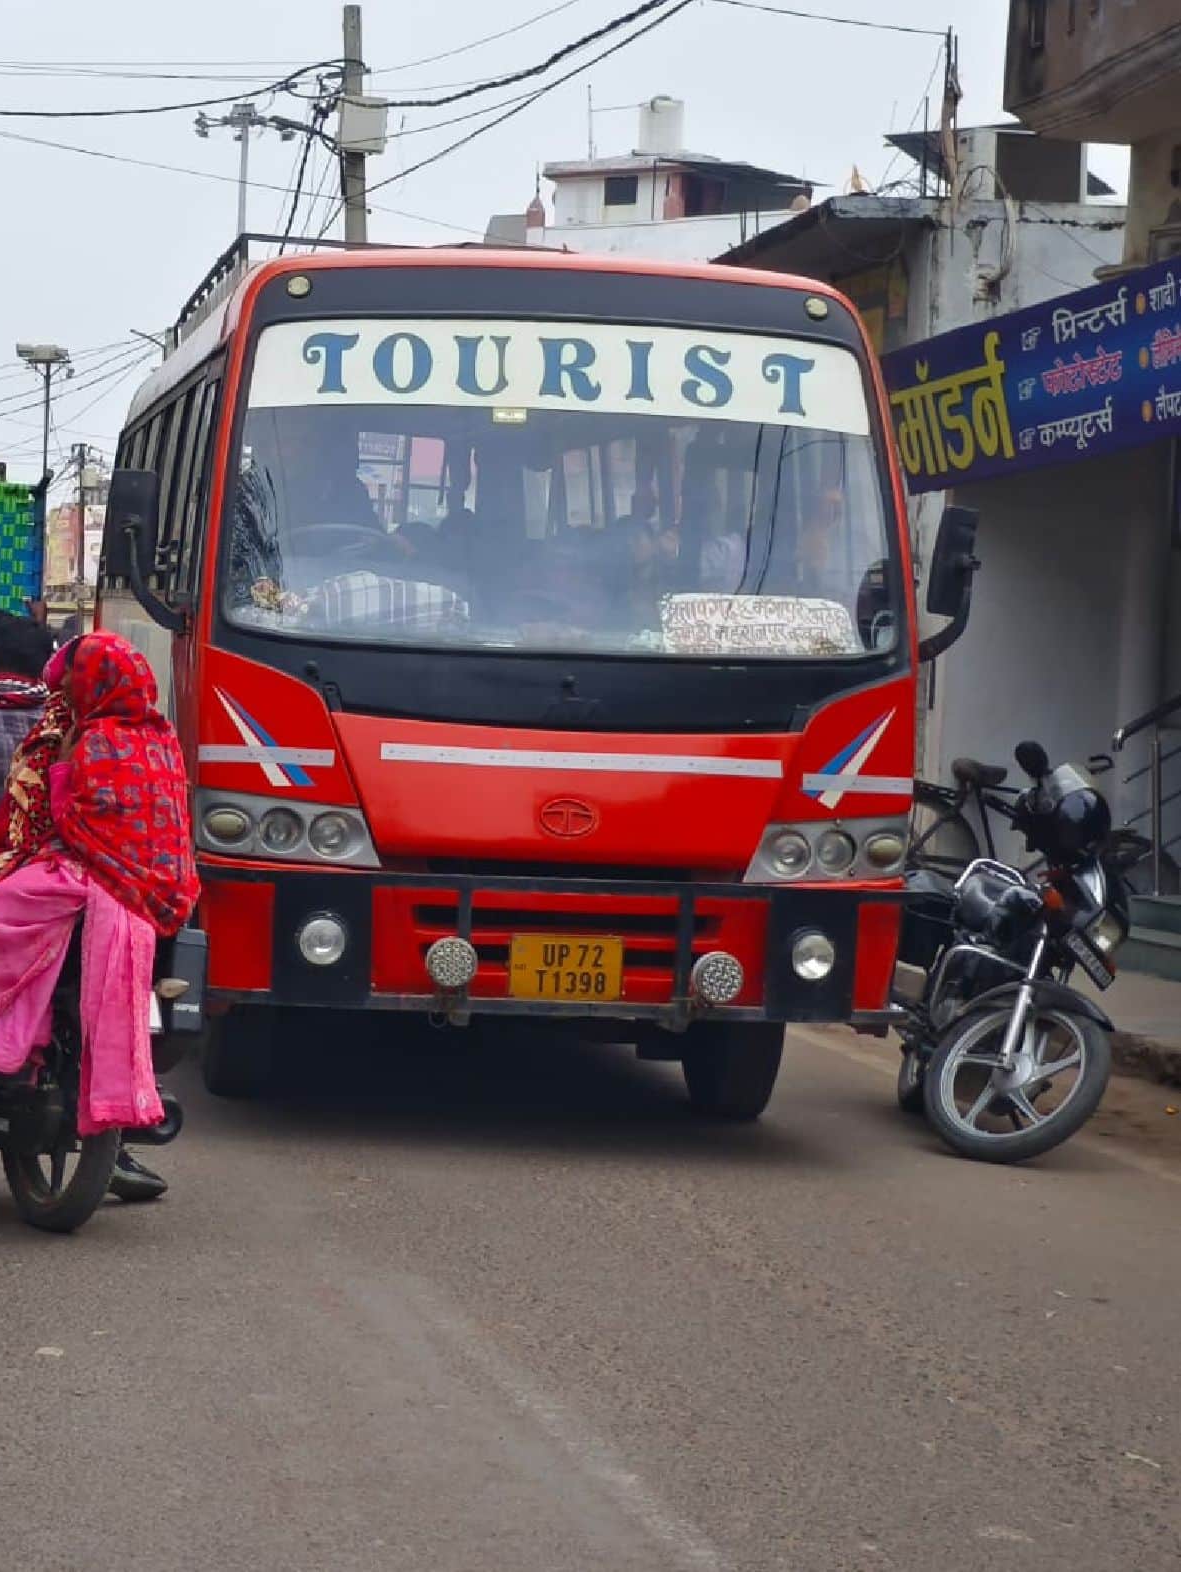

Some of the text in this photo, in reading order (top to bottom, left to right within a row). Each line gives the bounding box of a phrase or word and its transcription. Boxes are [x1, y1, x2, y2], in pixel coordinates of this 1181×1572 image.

[1052, 286, 1128, 345] प्रिन्टर्स
[302, 331, 816, 417] TOURIST
[543, 944, 605, 968] UP 72
[535, 969, 607, 994] T1398
